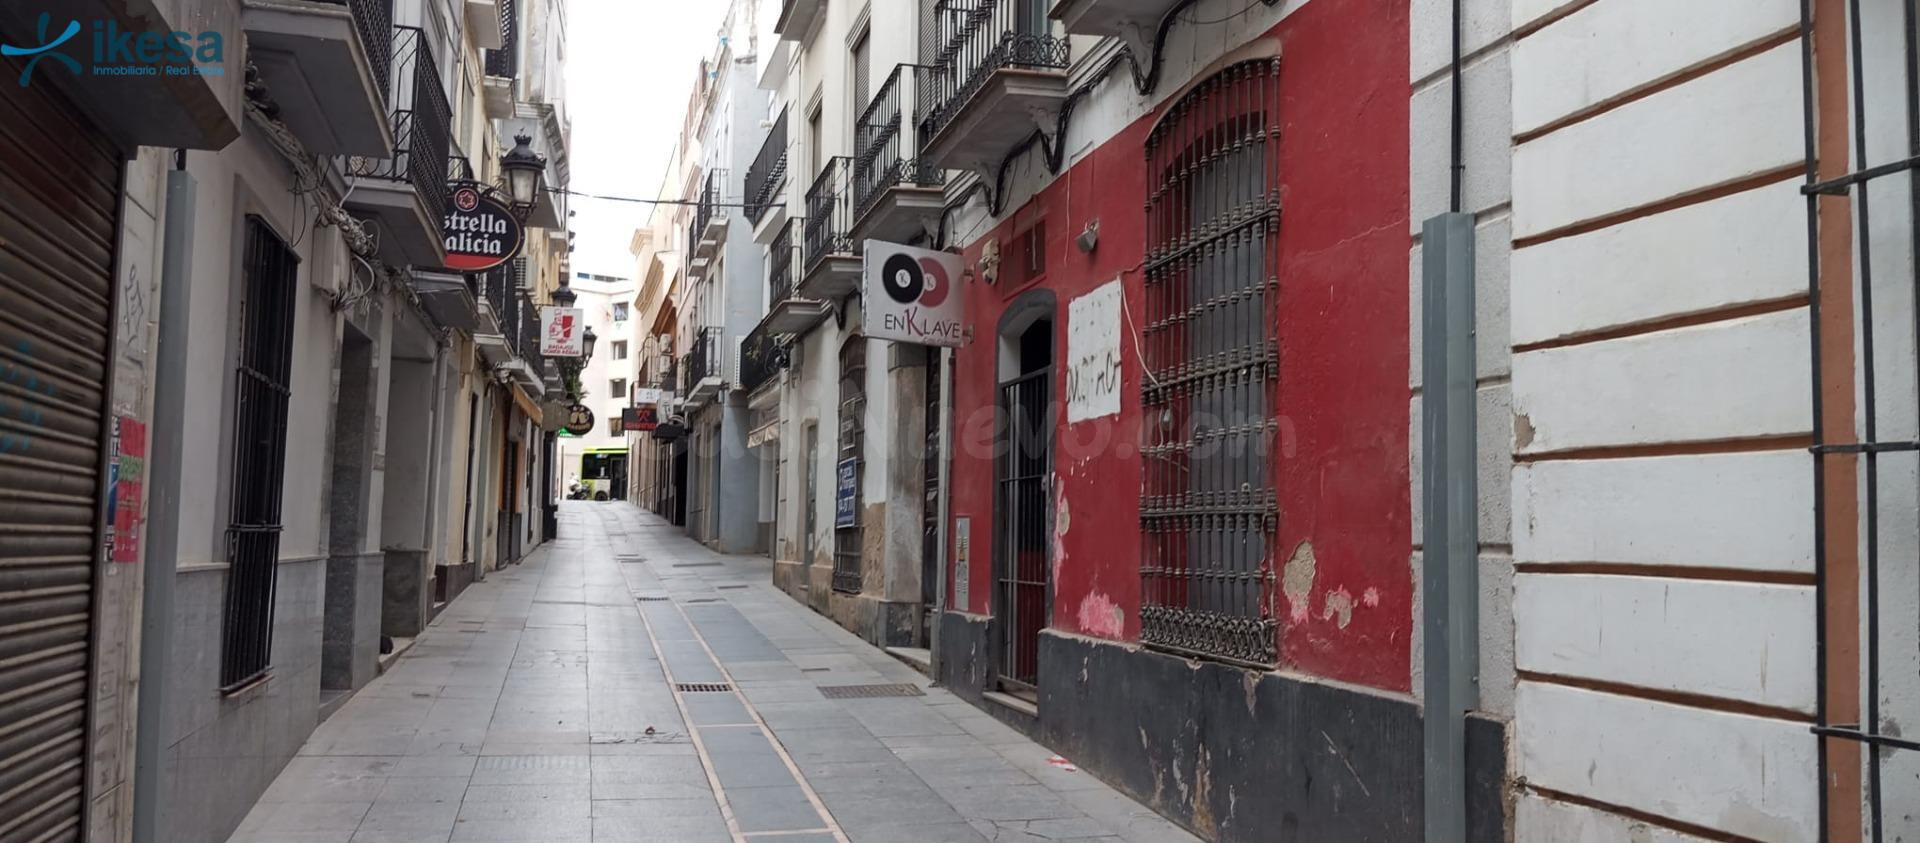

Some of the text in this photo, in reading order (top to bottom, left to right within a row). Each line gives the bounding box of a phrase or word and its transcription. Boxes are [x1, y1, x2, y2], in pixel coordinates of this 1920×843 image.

[444, 211, 507, 234] strella
[445, 232, 502, 254] alicia
[885, 306, 960, 338] ENKLAVE
